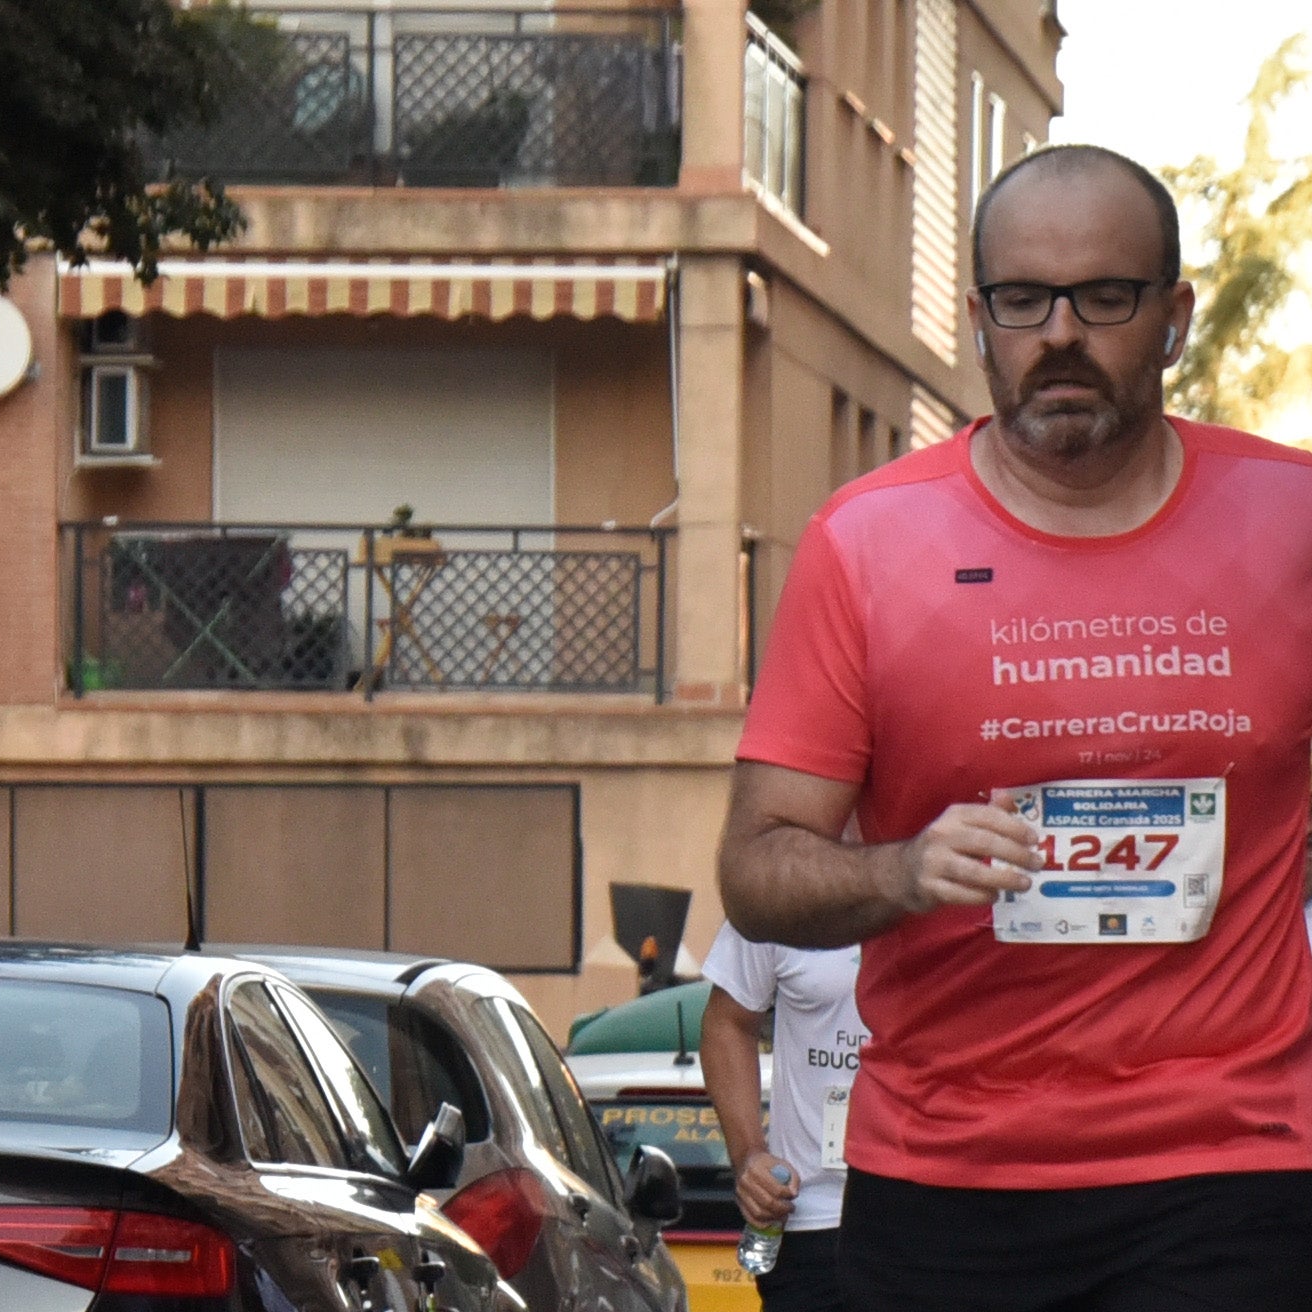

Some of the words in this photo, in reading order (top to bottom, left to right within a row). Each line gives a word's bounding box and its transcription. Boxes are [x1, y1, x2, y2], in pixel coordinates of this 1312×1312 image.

[990, 614, 1177, 645] kilómetros
[1186, 609, 1228, 636] de
[992, 644, 1232, 685] humanidad
[980, 709, 1252, 740] #CarreraCruzRoja
[1046, 815, 1097, 826] ASPACE
[1099, 814, 1151, 827] Granada
[1152, 814, 1182, 826] 2025
[1072, 801, 1149, 812] SOLIDARIA
[1037, 834, 1180, 871] 1247
